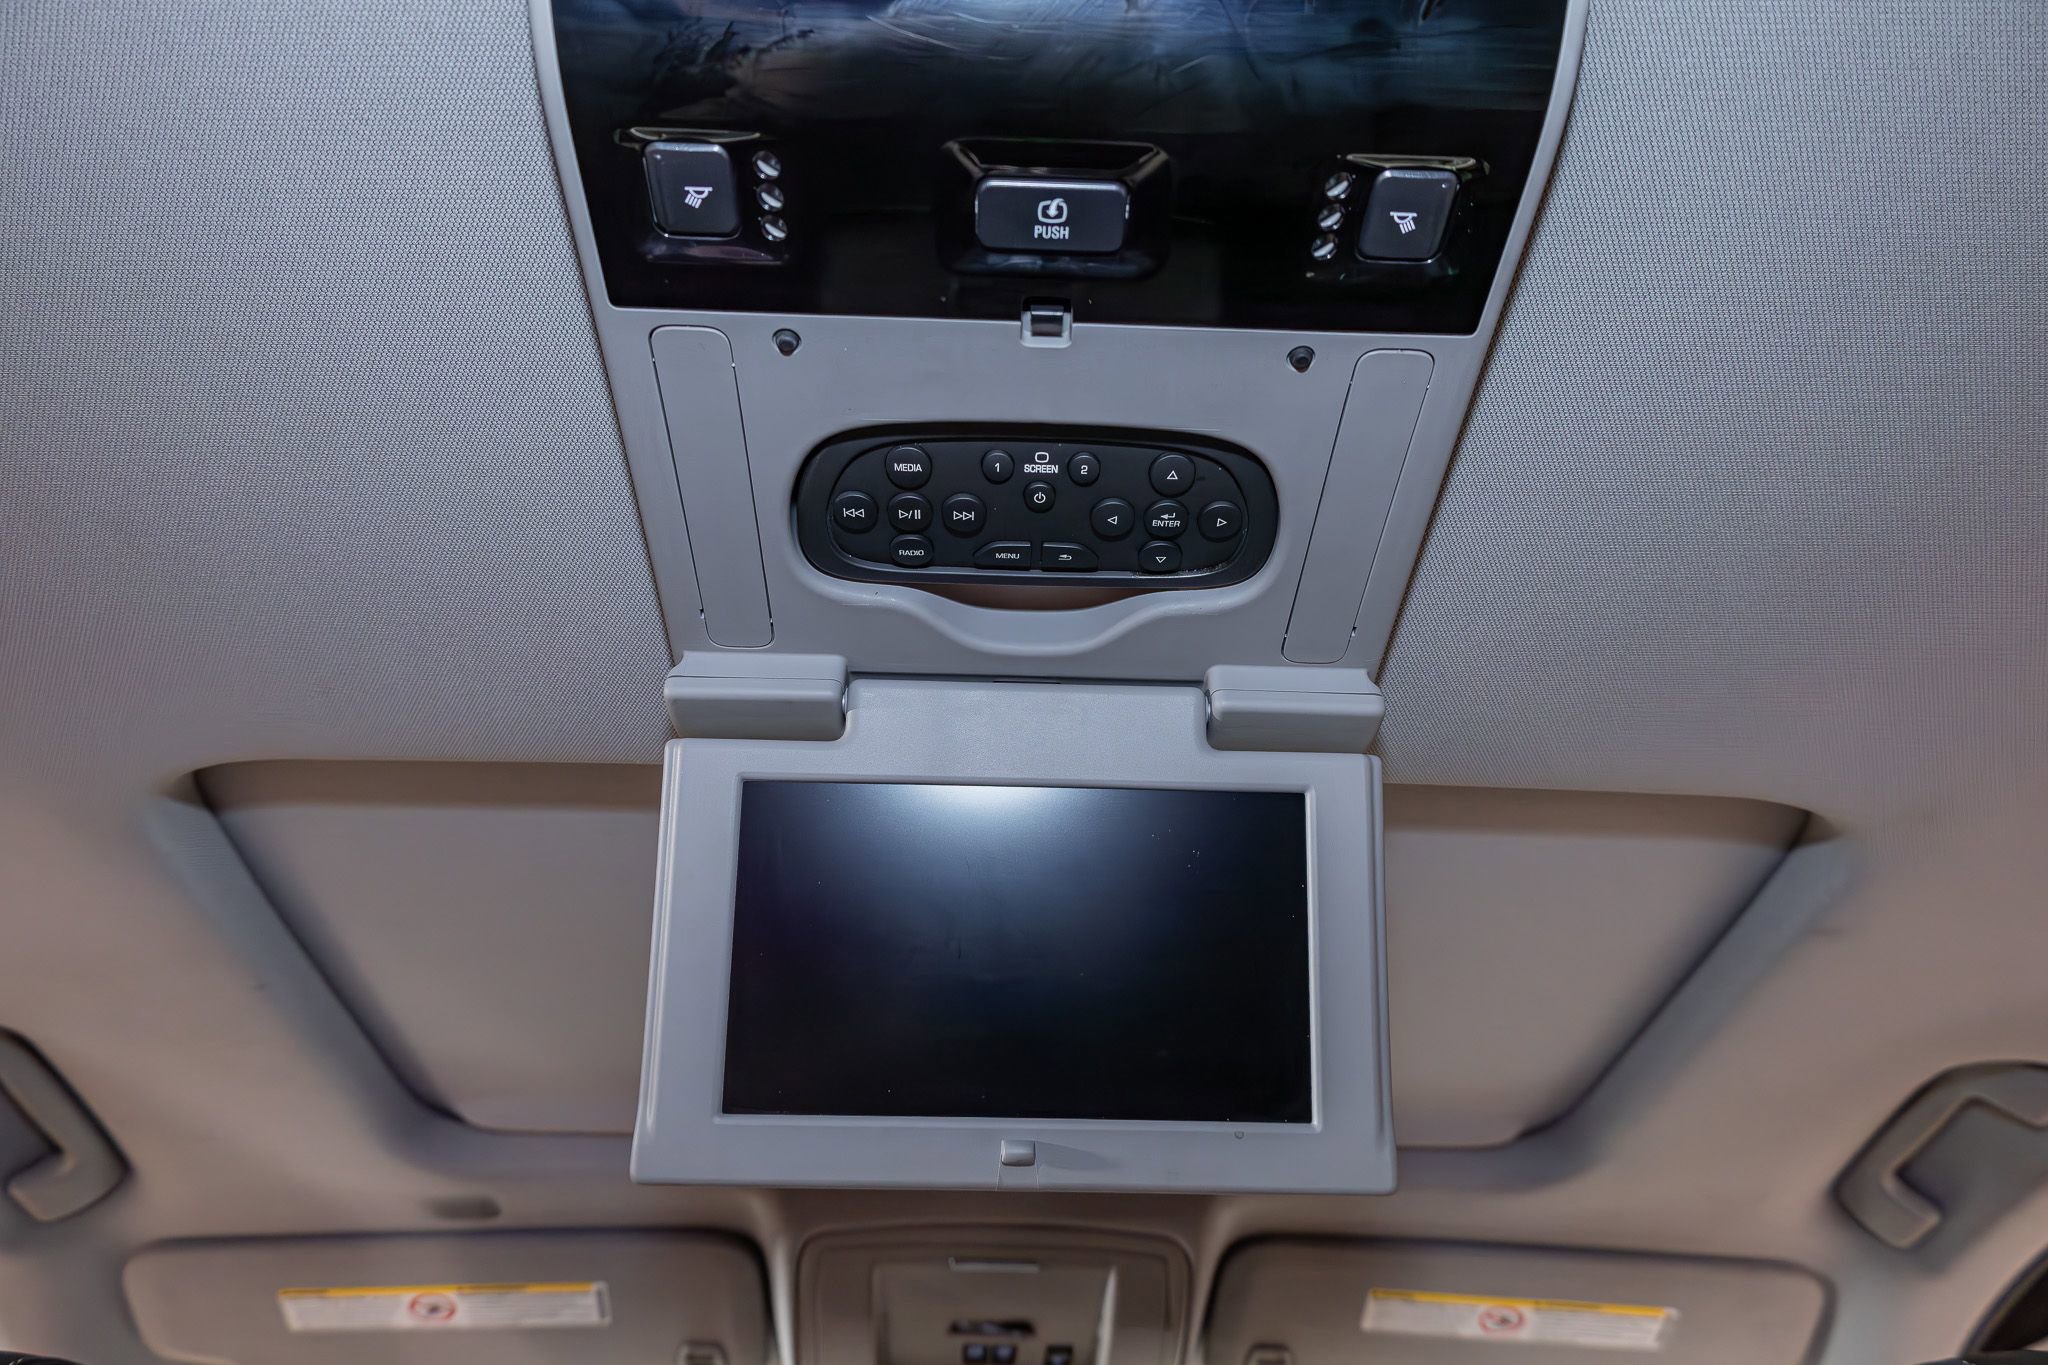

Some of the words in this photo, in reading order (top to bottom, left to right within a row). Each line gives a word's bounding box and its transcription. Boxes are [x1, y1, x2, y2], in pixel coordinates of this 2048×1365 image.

[1034, 224, 1070, 240] PUSH
[894, 462, 923, 472] MEDIA
[994, 462, 1000, 473] 1
[1024, 464, 1059, 474] SCREEN
[1080, 465, 1089, 475] 2
[1152, 519, 1181, 528] ENTER
